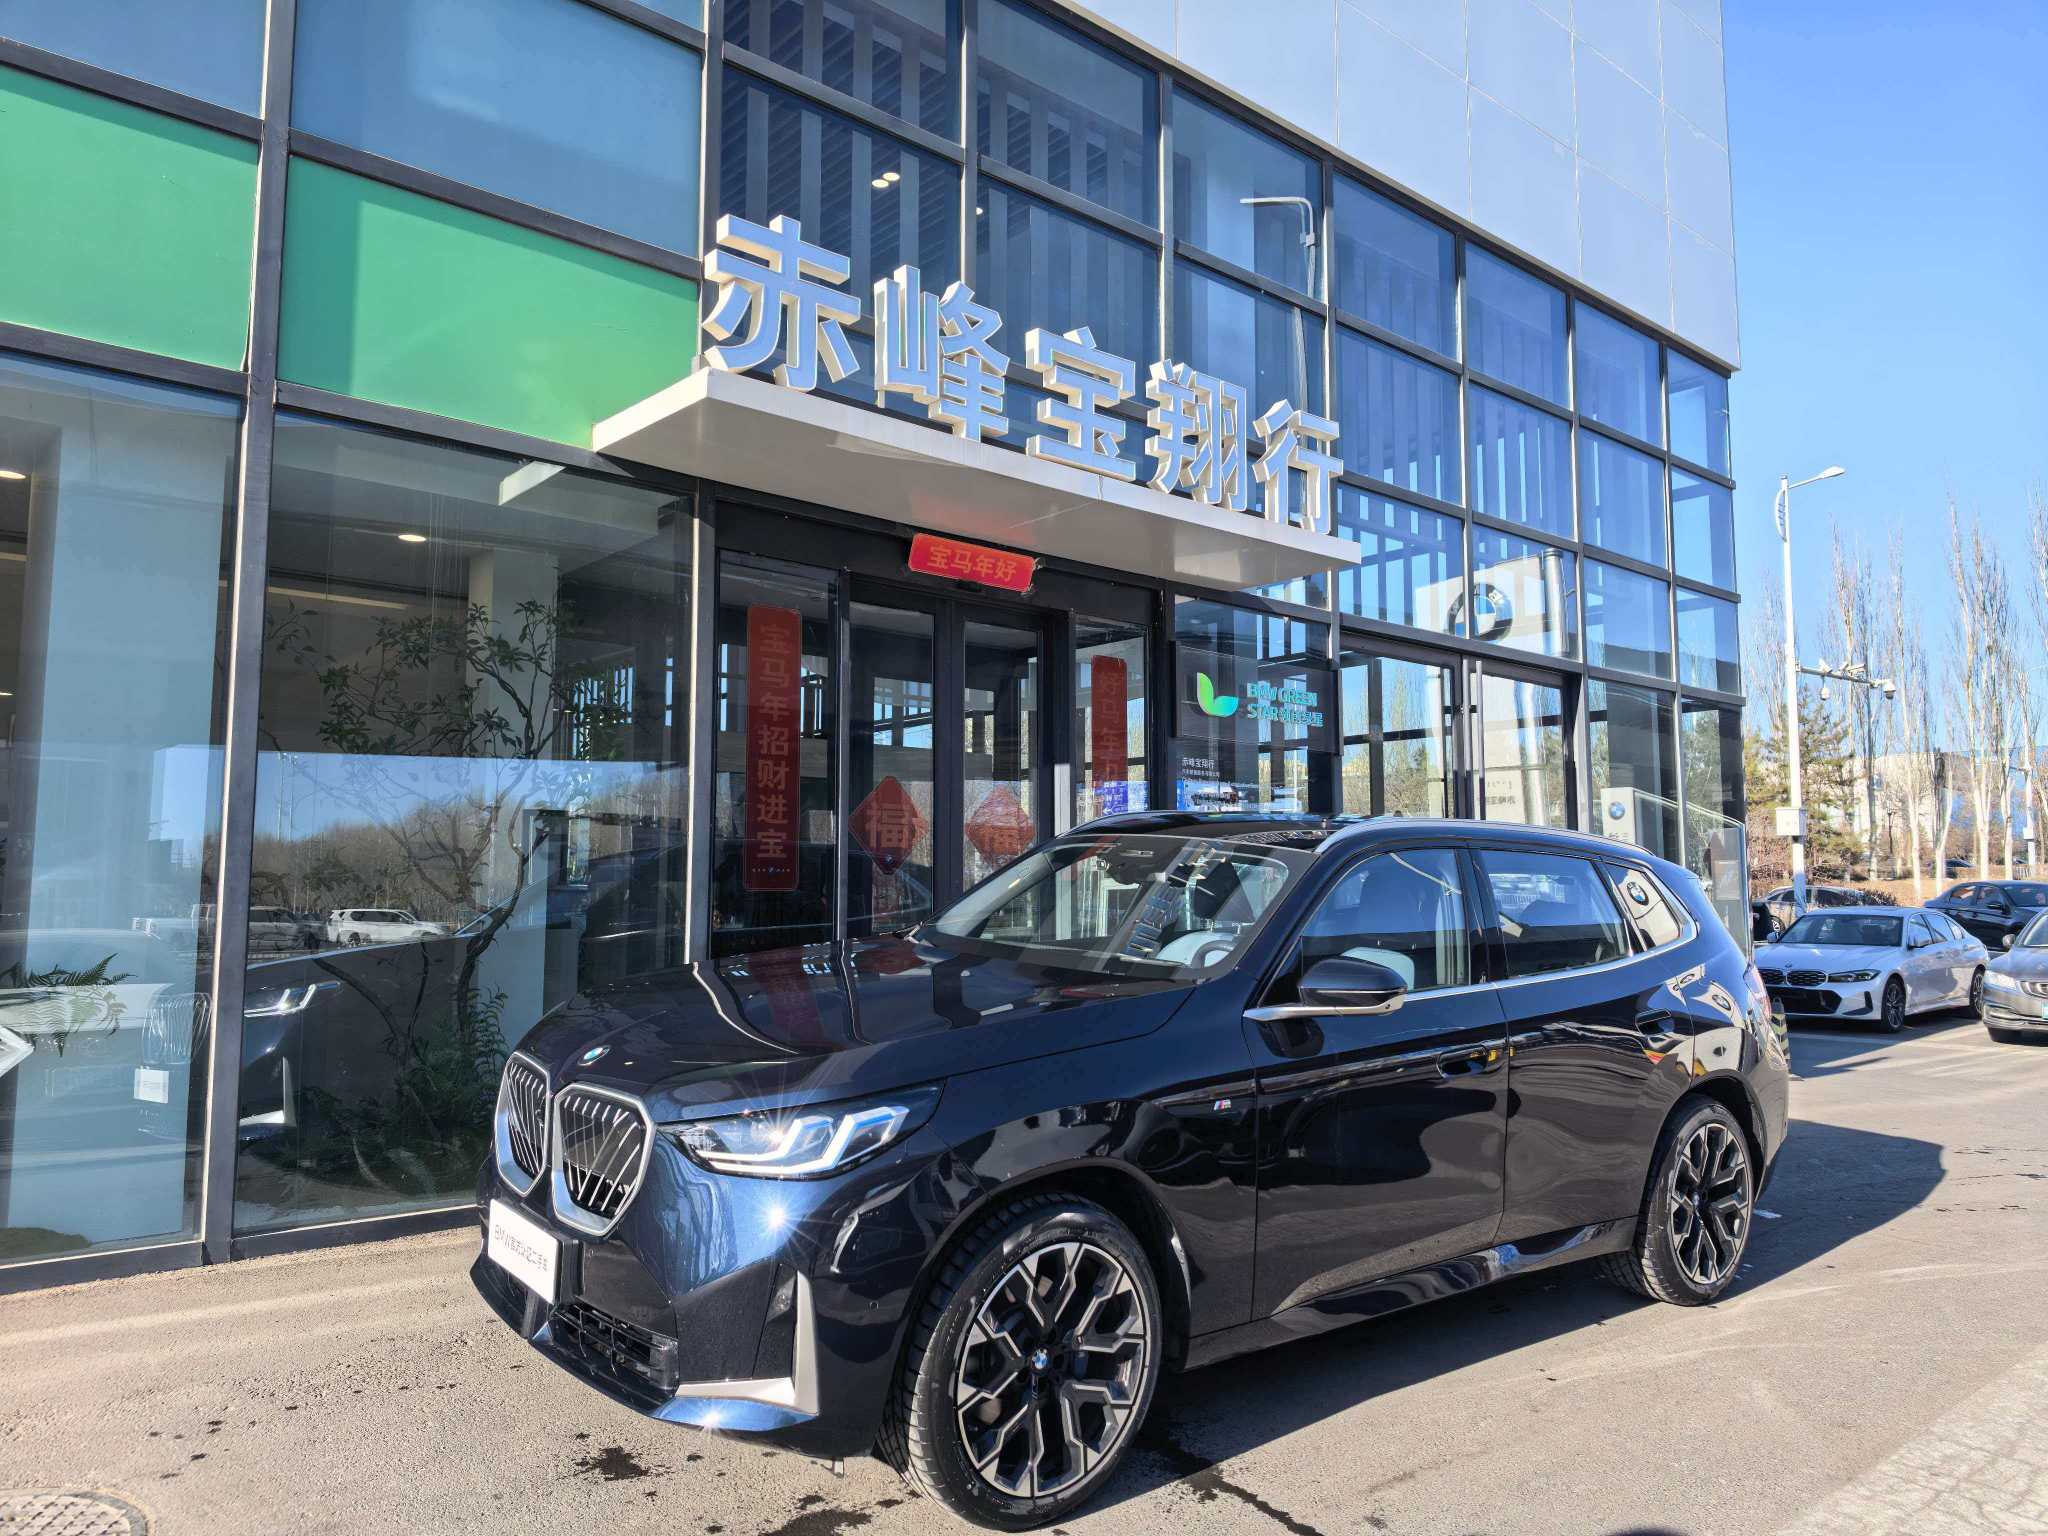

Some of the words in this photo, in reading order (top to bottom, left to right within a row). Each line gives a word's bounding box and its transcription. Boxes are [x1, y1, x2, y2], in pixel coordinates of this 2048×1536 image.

[702, 214, 1345, 536] 赤峰宝翔行
[927, 544, 1017, 582] 宝马年好
[1278, 687, 1317, 707] GREEN
[756, 624, 792, 860] 宝马年招财进宝
[866, 800, 912, 849] 福
